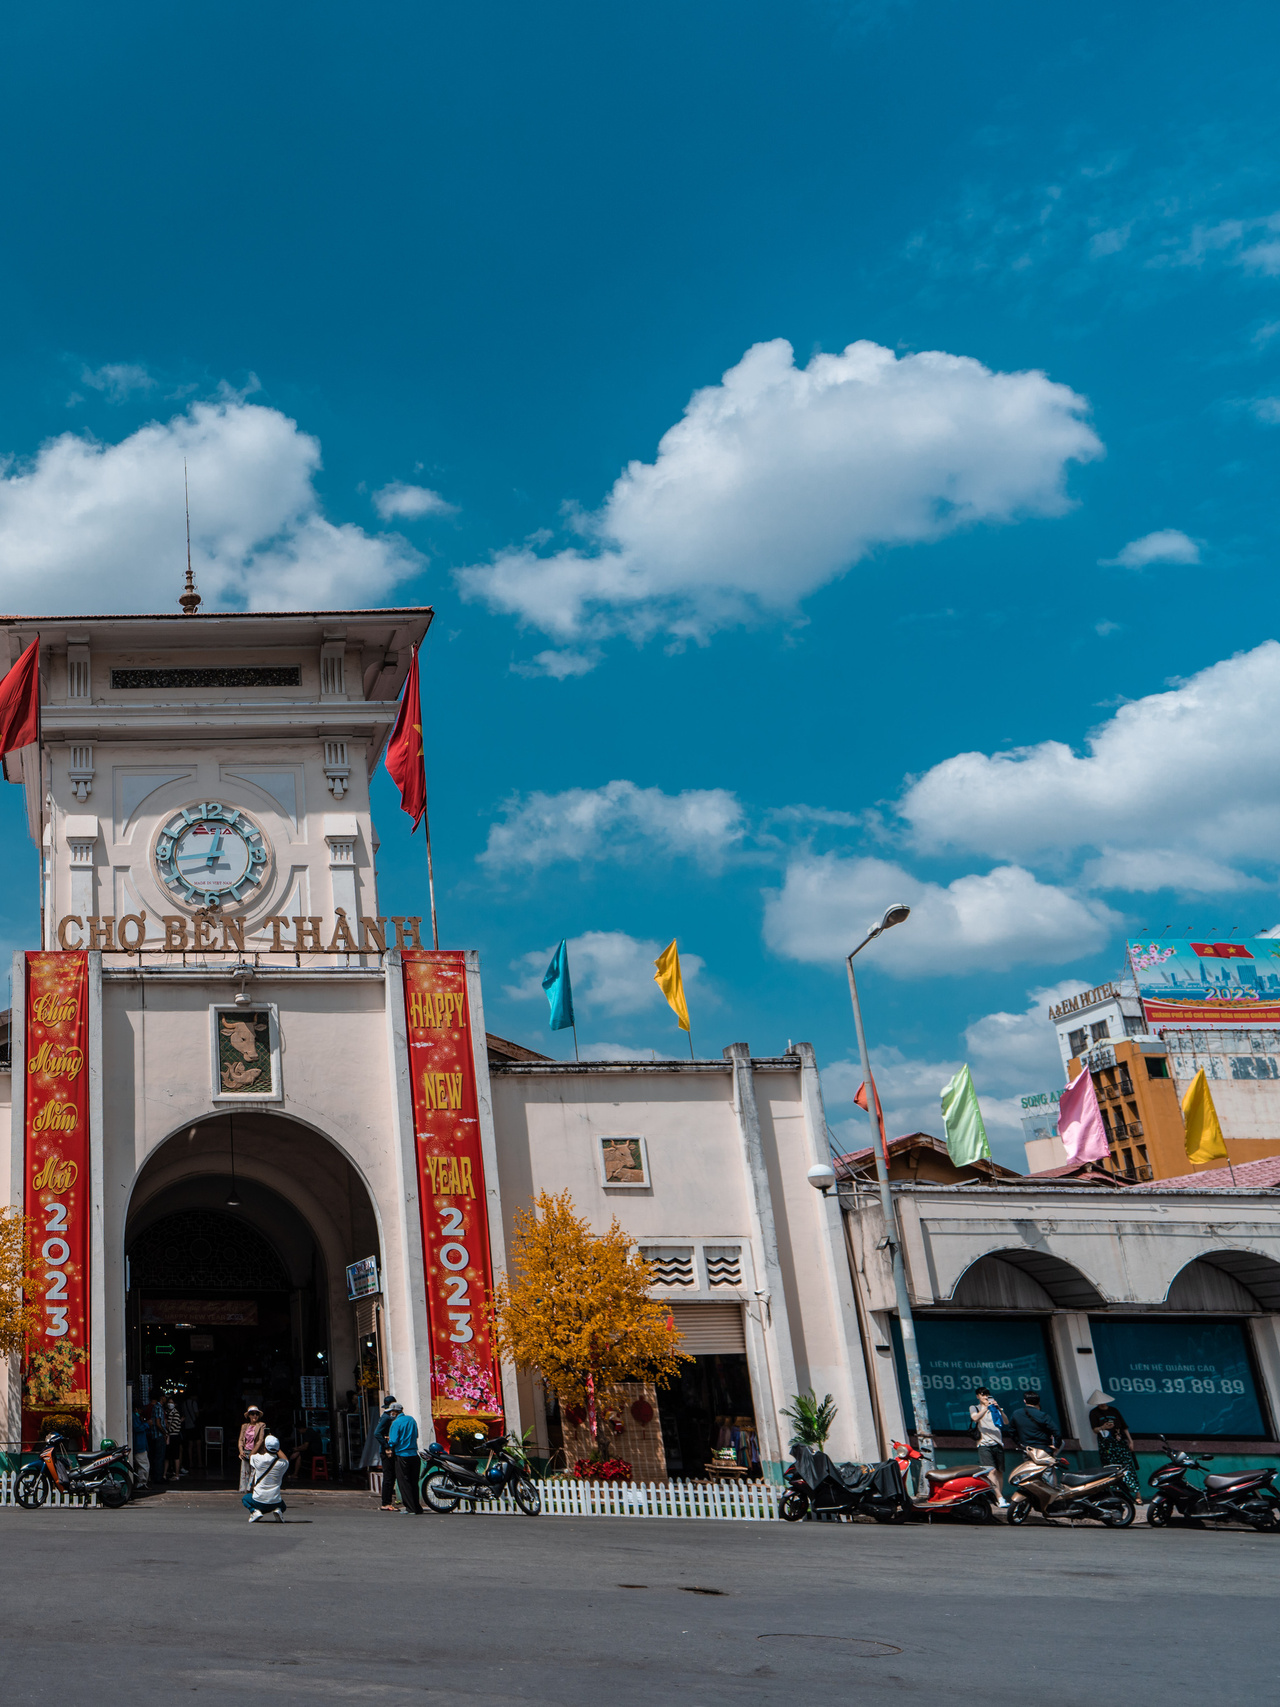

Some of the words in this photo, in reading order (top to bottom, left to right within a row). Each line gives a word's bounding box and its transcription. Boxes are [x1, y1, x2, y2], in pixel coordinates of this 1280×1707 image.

[198, 803, 223, 819] 12
[156, 845, 171, 860] 9
[251, 847, 266, 863] 3
[204, 891, 220, 907] 6
[58, 911, 146, 957] CHỢ
[162, 904, 246, 950] BẾN
[263, 907, 424, 951] THÀNH
[33, 993, 78, 1027] Chúc
[1048, 996, 1080, 1020] A&EM
[1080, 982, 1116, 1007] HOTEL
[1205, 986, 1260, 1001] 2023
[411, 993, 465, 1028] HAPPY
[28, 1041, 84, 1081] Mừng
[424, 1073, 463, 1109] NEW
[1021, 1093, 1048, 1108] SONG
[33, 1099, 78, 1132] Năm
[33, 1156, 78, 1195] Mới
[426, 1157, 476, 1199] YEAR
[922, 1375, 1042, 1391] 969.3989.89
[1109, 1377, 1245, 1394] 0969.39.89.89
